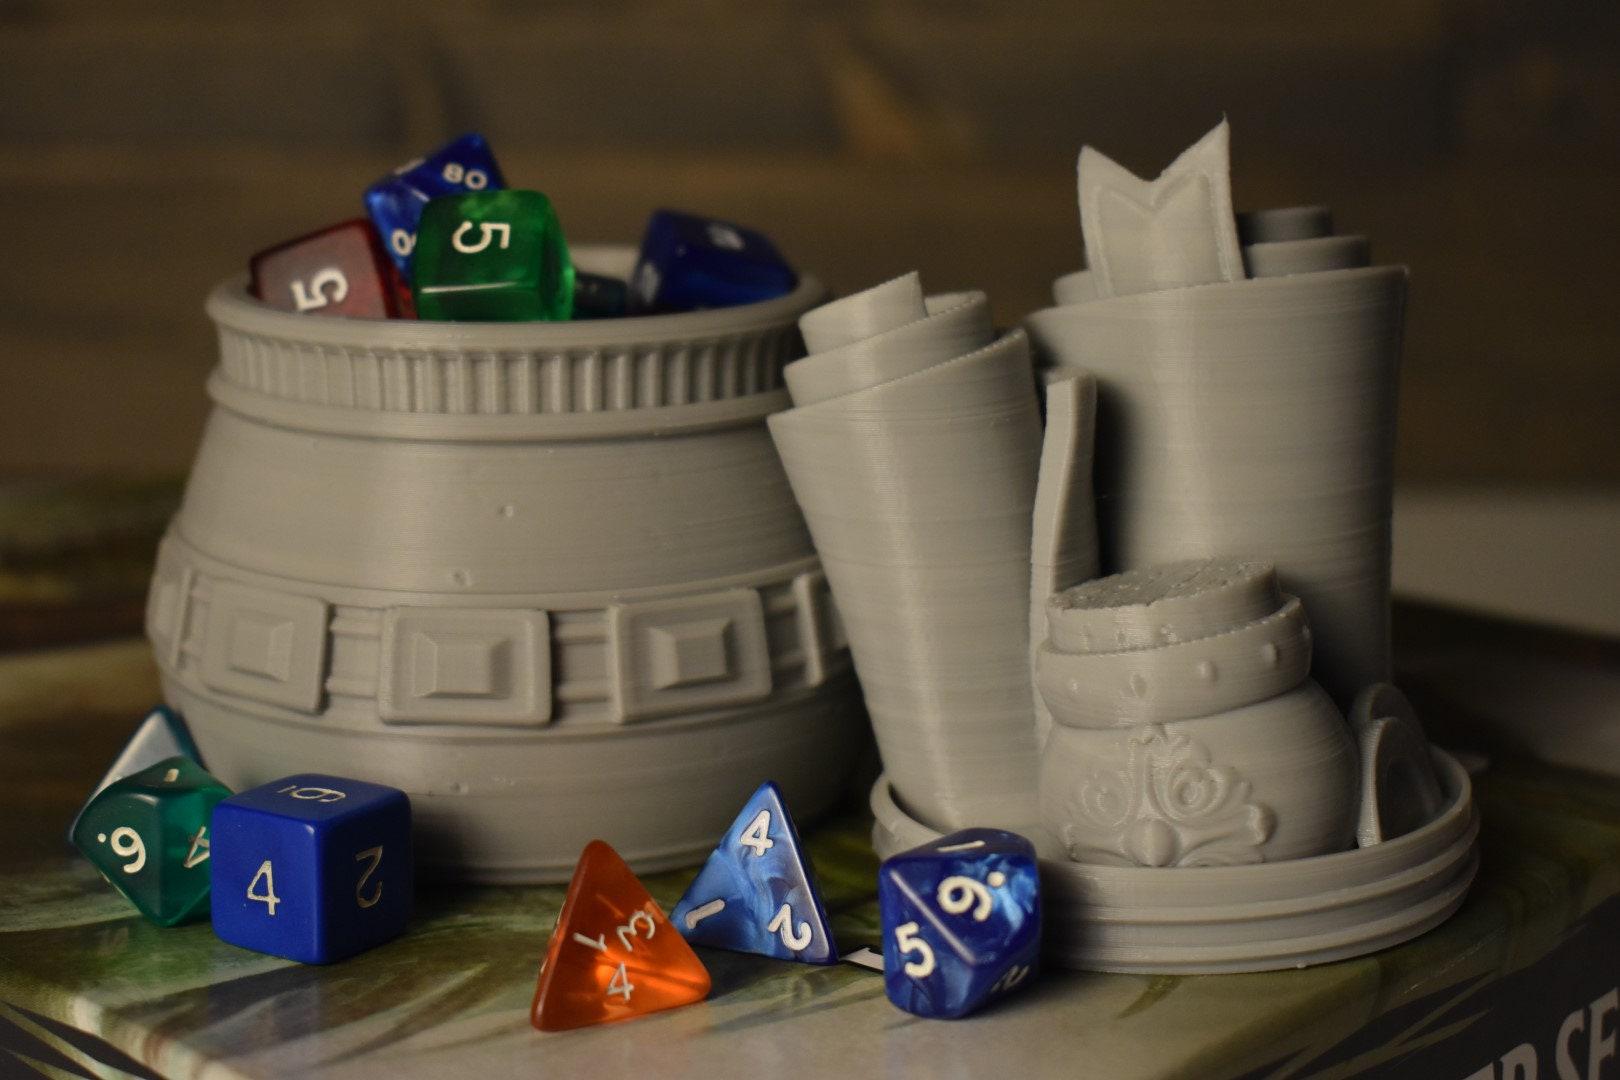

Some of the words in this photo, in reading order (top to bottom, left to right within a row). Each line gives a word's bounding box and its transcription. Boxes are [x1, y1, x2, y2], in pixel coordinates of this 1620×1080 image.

[452, 221, 511, 254] 5
[289, 268, 348, 311] 5
[740, 810, 774, 857] 4
[247, 860, 281, 915] 4
[354, 847, 383, 908] 2
[616, 910, 656, 952] 3
[768, 903, 812, 951] 2
[895, 922, 936, 979] 5
[607, 960, 635, 1001] 4
